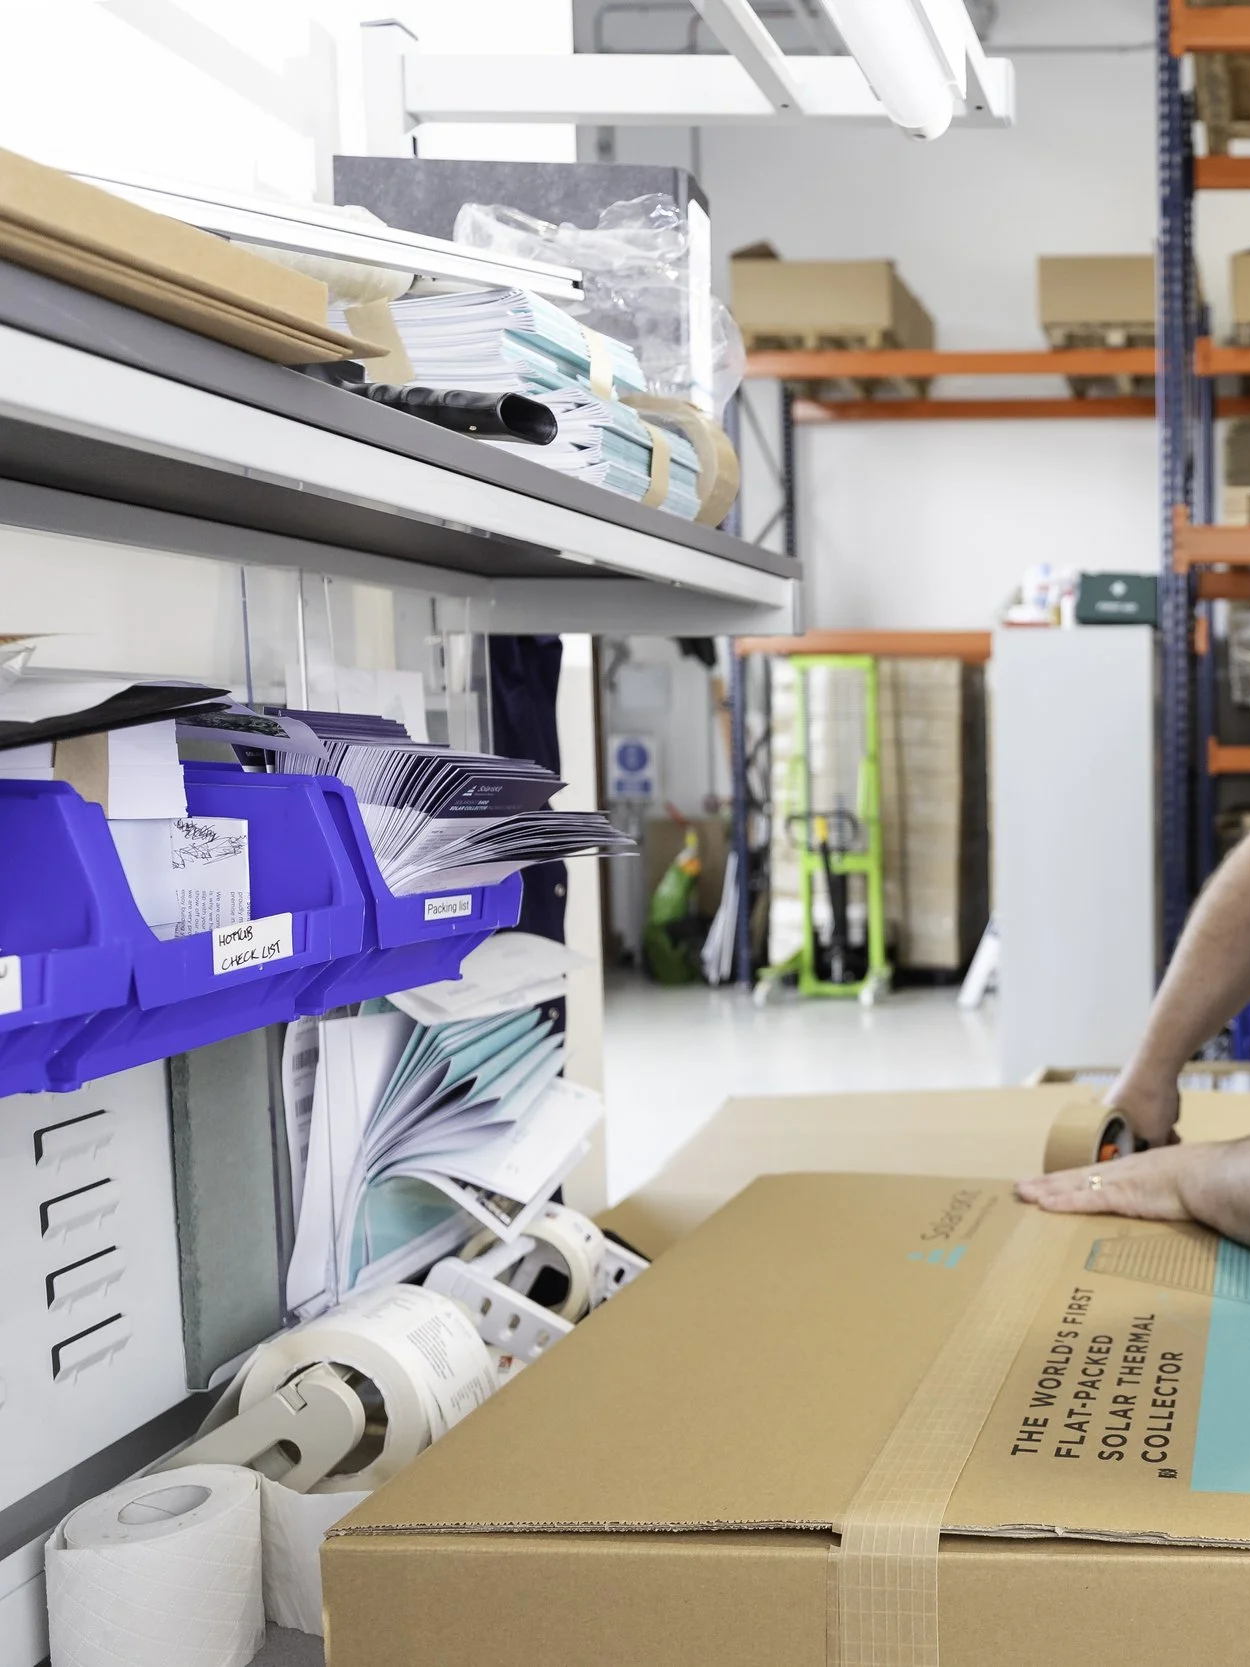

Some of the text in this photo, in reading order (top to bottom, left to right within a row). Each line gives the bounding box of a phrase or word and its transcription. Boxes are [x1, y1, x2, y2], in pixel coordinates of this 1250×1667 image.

[221, 940, 281, 971] CHECK LIST
[427, 900, 470, 916] Packing list
[1010, 1286, 1095, 1456] THE WORLD'S FIRST
[1054, 1334, 1114, 1459] FLAT-PACKED
[1097, 1313, 1155, 1462] SOLAR THERMAL
[1140, 1351, 1184, 1464] COLLECTOR
